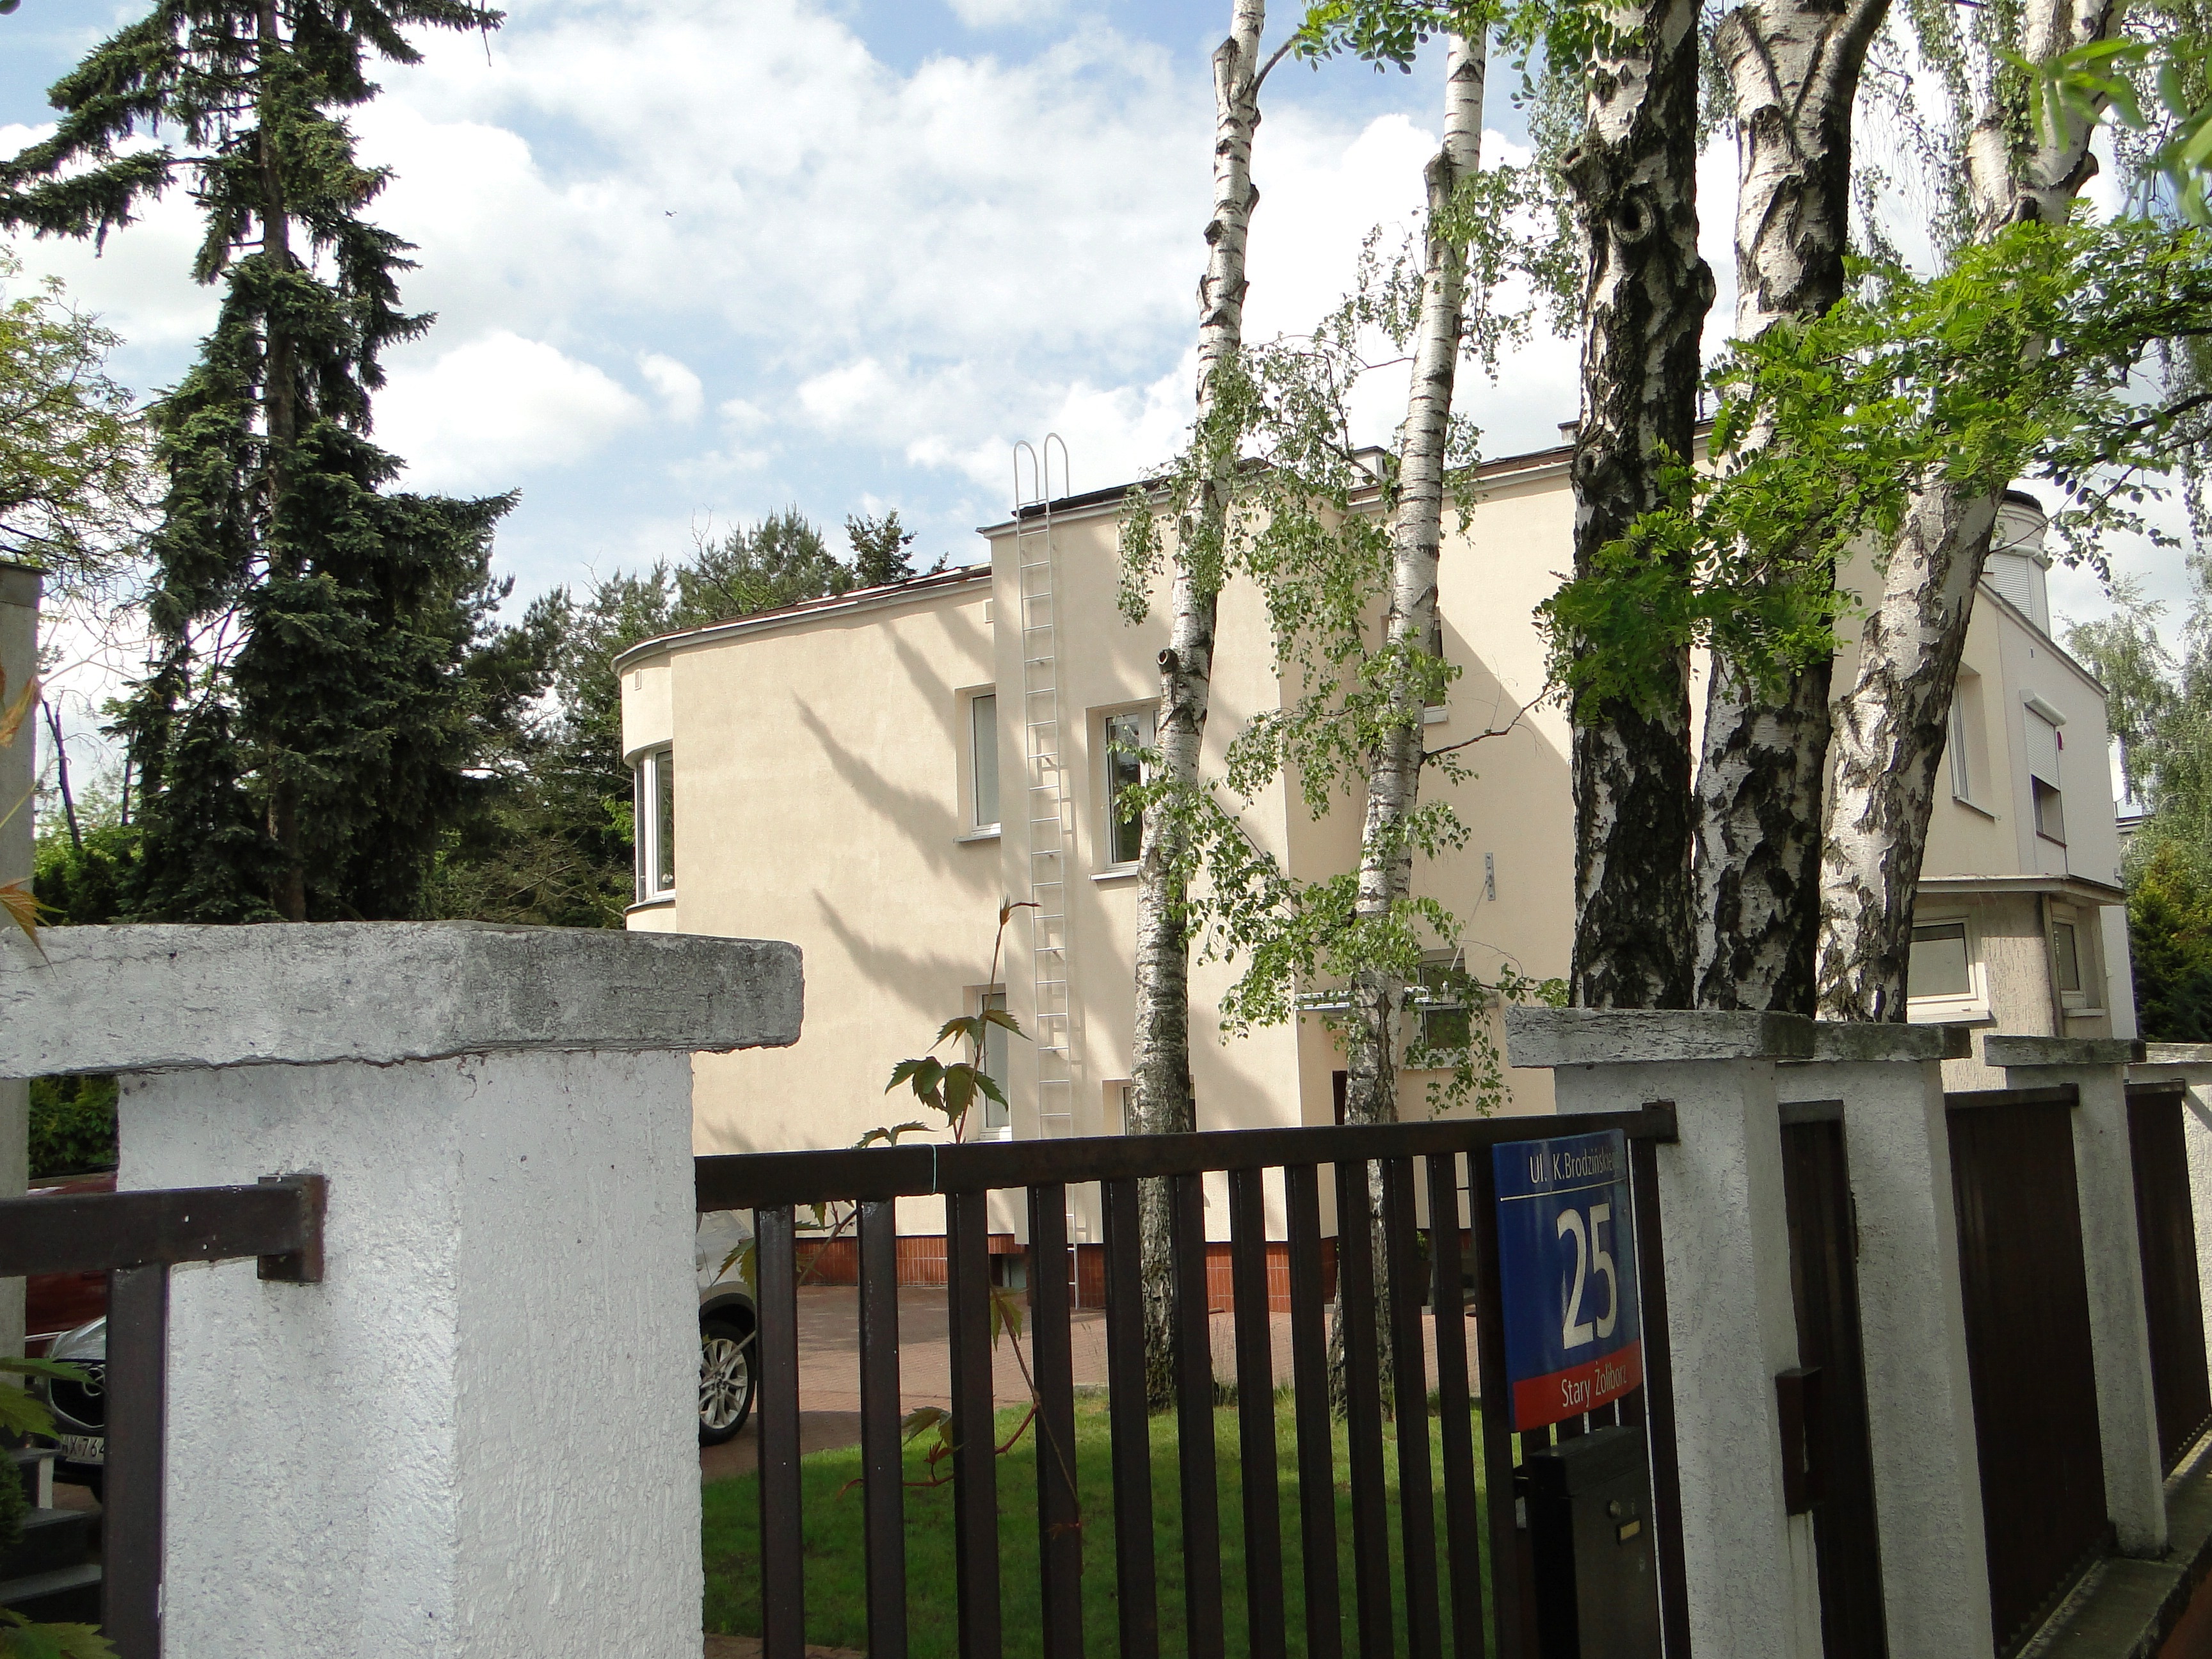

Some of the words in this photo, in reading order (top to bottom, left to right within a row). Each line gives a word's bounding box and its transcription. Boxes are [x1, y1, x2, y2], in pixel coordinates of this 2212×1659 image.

[1530, 1153, 1548, 1184] Ul.
[1557, 1203, 1618, 1350] 25
[1561, 1379, 1591, 1409] Stary
[1594, 1360, 1628, 1397] Żoliborz
